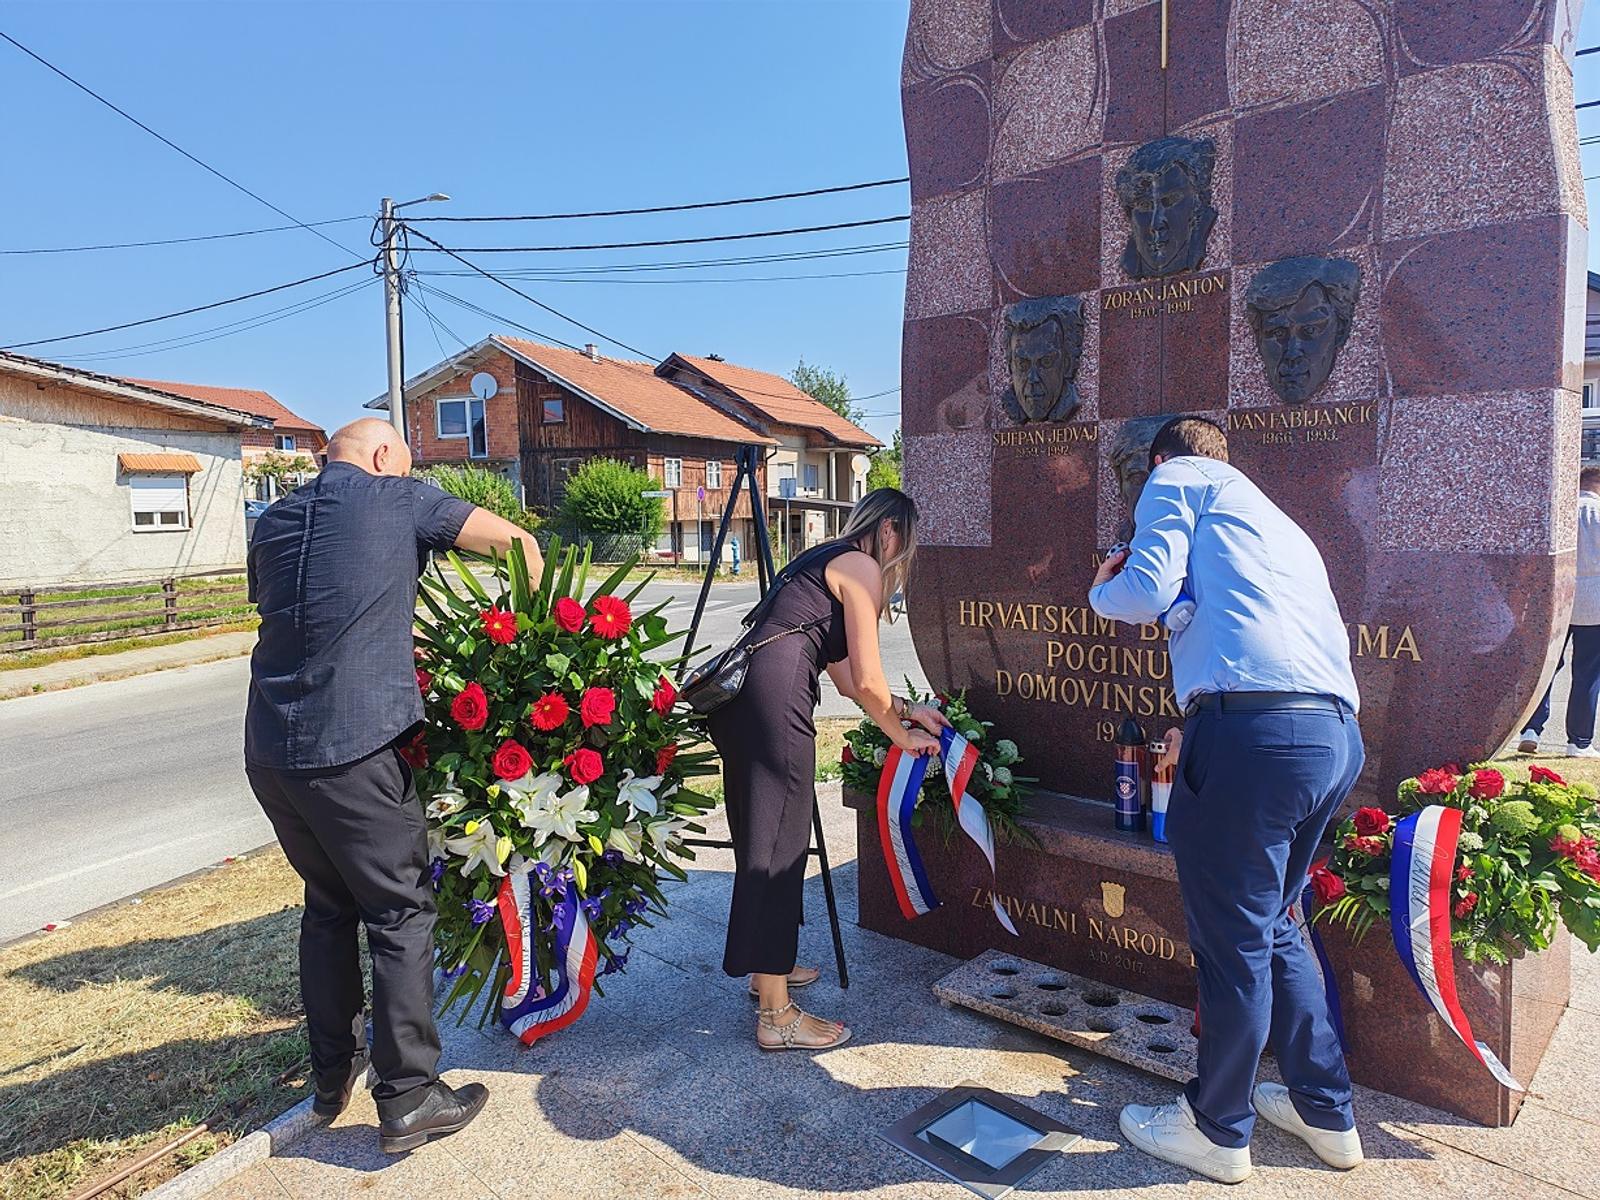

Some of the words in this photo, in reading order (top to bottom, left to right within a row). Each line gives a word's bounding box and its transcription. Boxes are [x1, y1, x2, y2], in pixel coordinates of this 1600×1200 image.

[1104, 286, 1154, 310] ZORAN
[1157, 275, 1225, 301] JANTON
[1227, 412, 1266, 431] IVAN
[1270, 400, 1379, 429] FABIJANČIĆ
[993, 430, 1045, 447] STJEPAN
[1048, 425, 1098, 443] JEDVAJ
[959, 600, 1118, 637] HRVATSKIM
[1046, 640, 1169, 680] POGINU
[995, 669, 1185, 718] DOMOVINSK
[971, 887, 1078, 935] ZAHVALNI
[1088, 918, 1176, 962] NAROD
